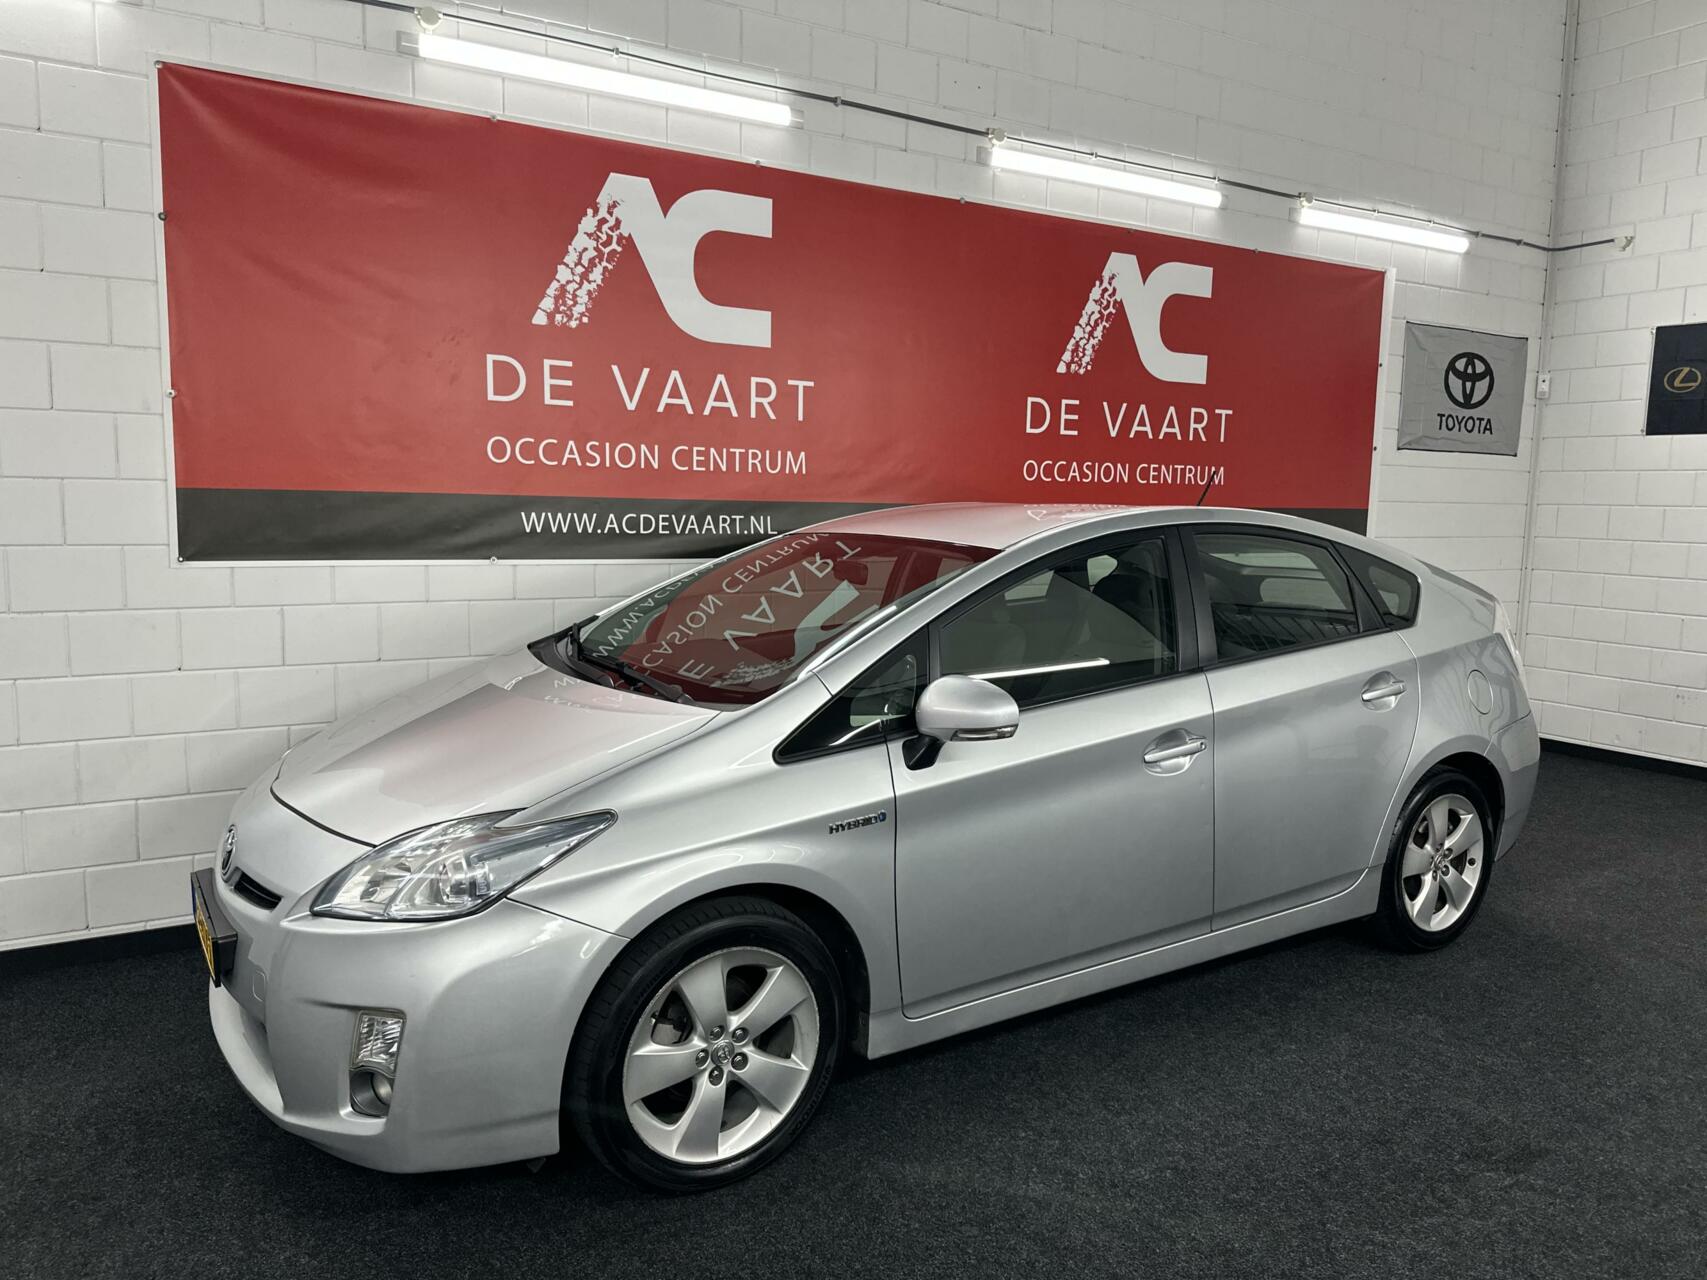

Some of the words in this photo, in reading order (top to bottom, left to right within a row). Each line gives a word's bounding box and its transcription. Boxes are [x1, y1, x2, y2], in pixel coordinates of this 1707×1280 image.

[486, 353, 574, 407] DE
[611, 364, 815, 421] VAART
[1025, 396, 1080, 436] DE
[1102, 401, 1233, 443] VAART
[1437, 413, 1493, 435] TOYOTA
[487, 435, 660, 469] OCCASION
[671, 445, 807, 475] CENTRUM
[1023, 459, 1129, 484] OCCASION
[1136, 463, 1224, 486] CENTRUM
[521, 511, 778, 535] WWW.ACDEVAART.NL
[828, 813, 879, 835] HYBRID
